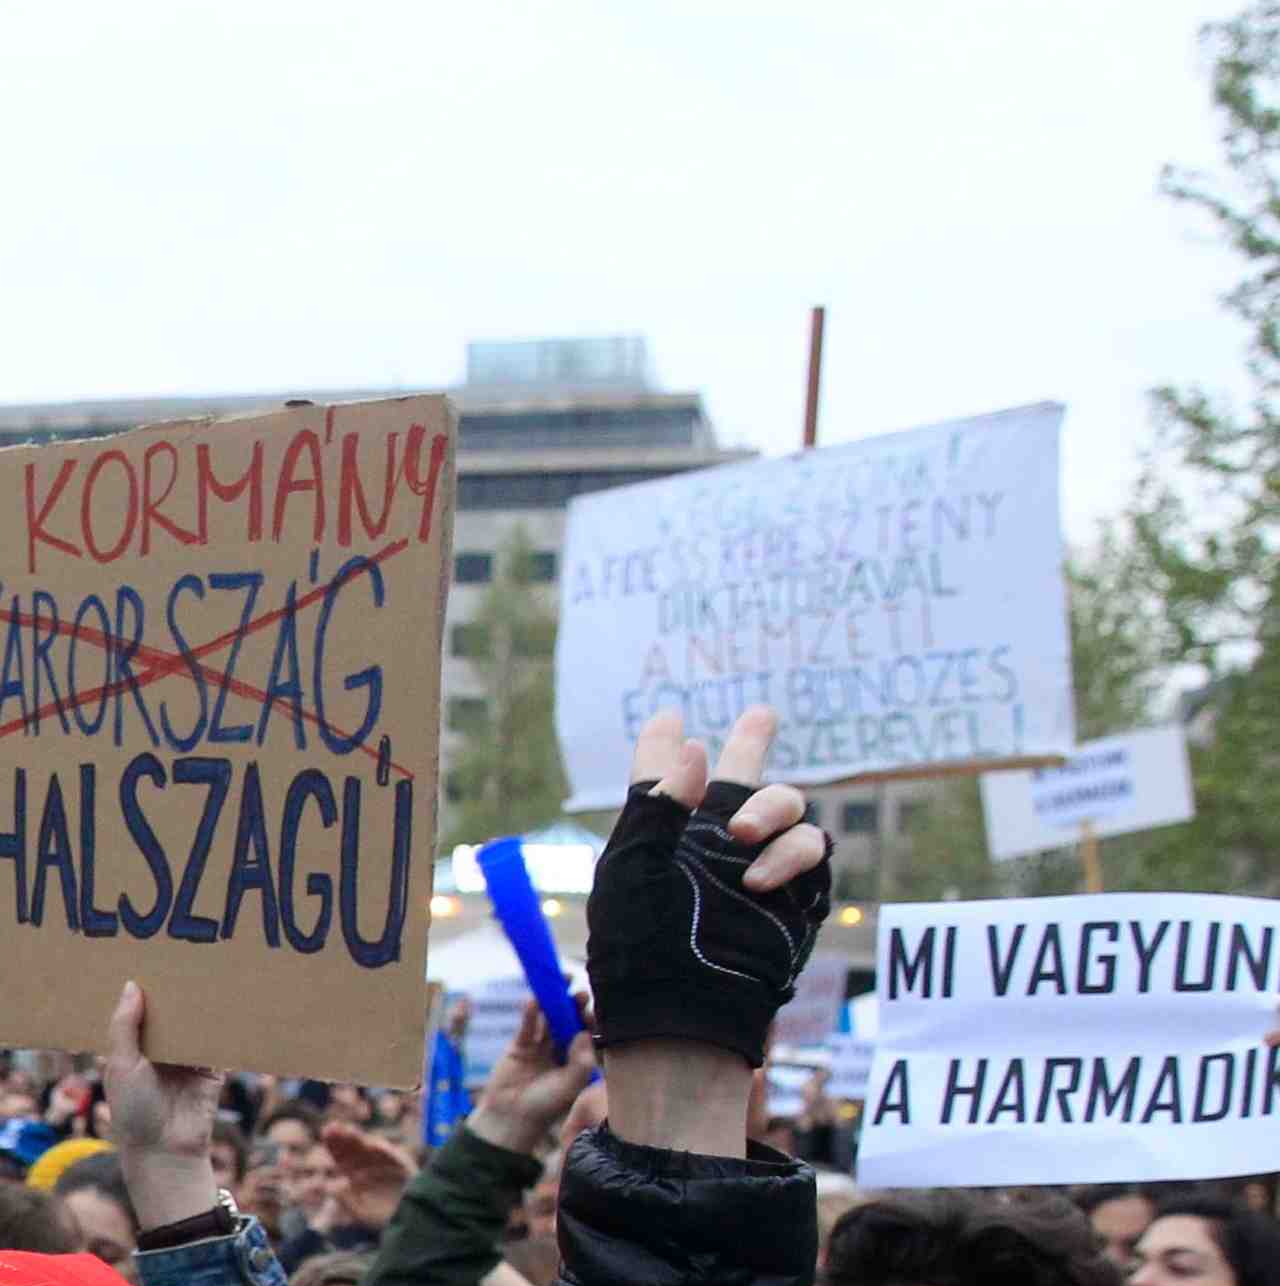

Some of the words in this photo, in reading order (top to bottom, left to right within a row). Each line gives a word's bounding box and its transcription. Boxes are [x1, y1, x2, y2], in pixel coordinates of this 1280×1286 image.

[25, 408, 447, 574] KORMÁNY
[889, 925, 958, 1000] MI
[987, 920, 1280, 997] VAGYUN
[872, 1059, 911, 1127] A
